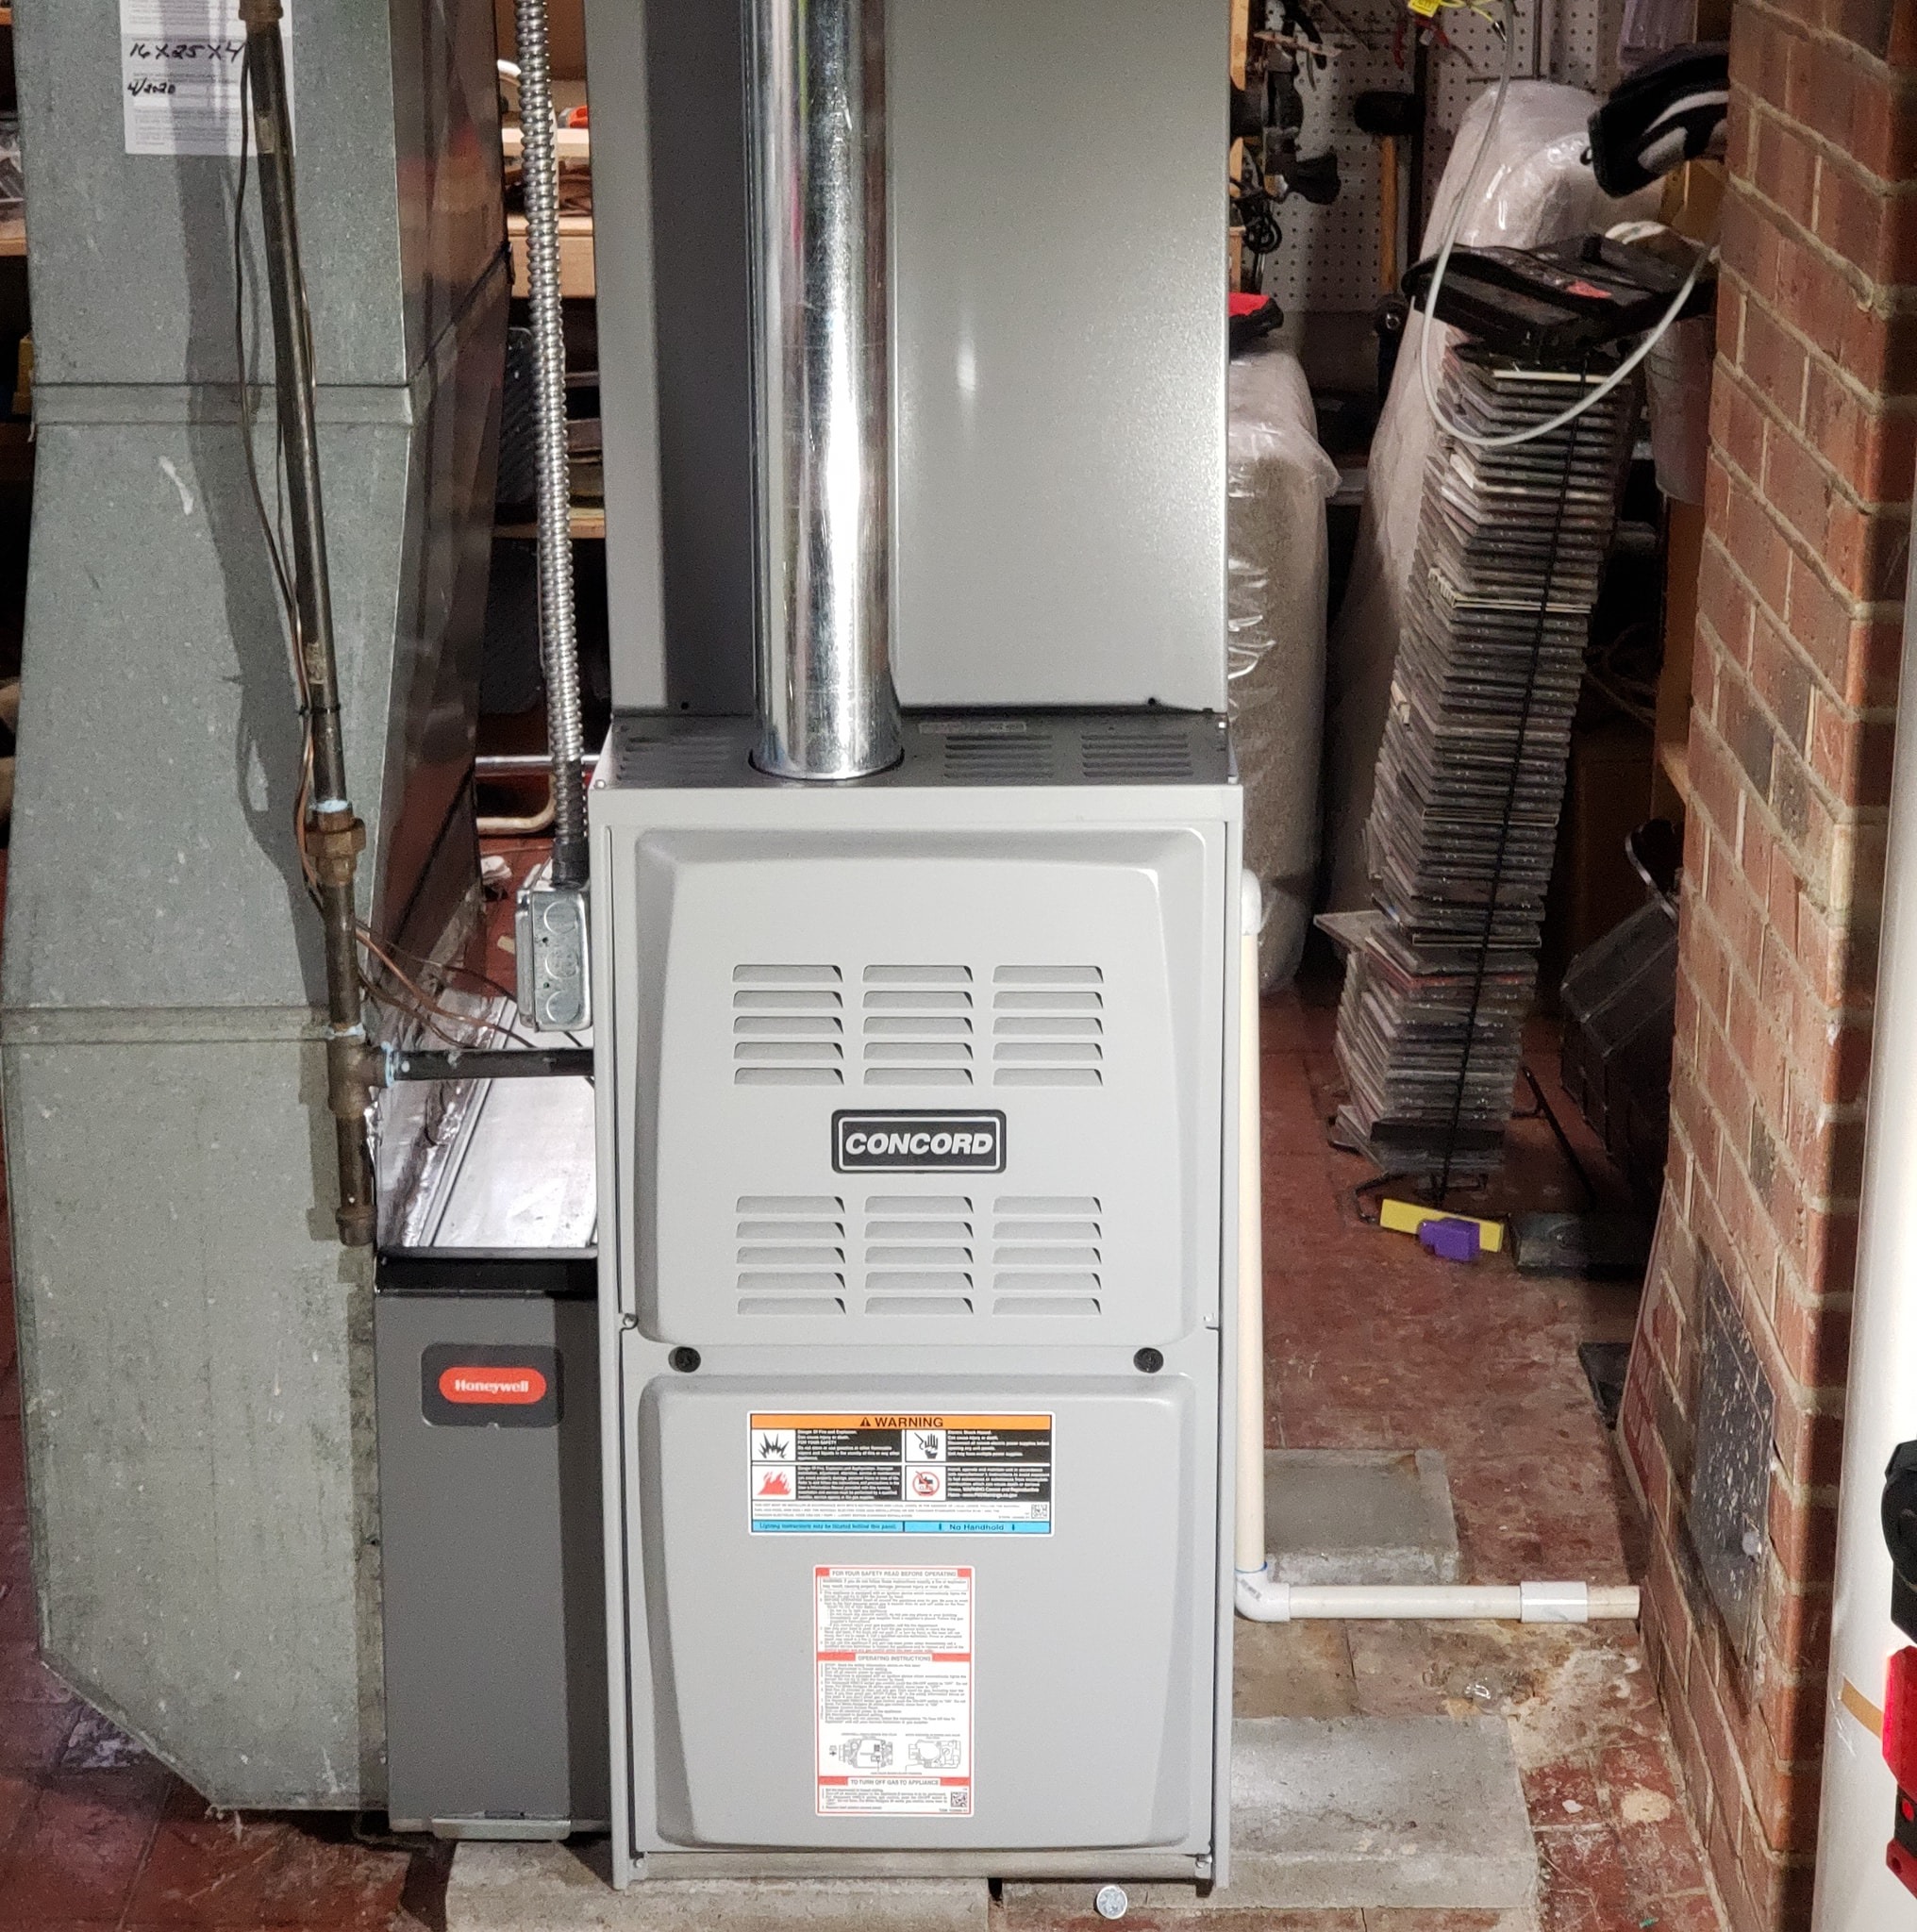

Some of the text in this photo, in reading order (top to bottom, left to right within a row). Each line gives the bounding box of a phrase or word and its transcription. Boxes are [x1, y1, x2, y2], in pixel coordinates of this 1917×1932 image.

[845, 1133, 993, 1155] CONCORD
[455, 1379, 529, 1394] Honeywell
[875, 1417, 943, 1427] WARNING
